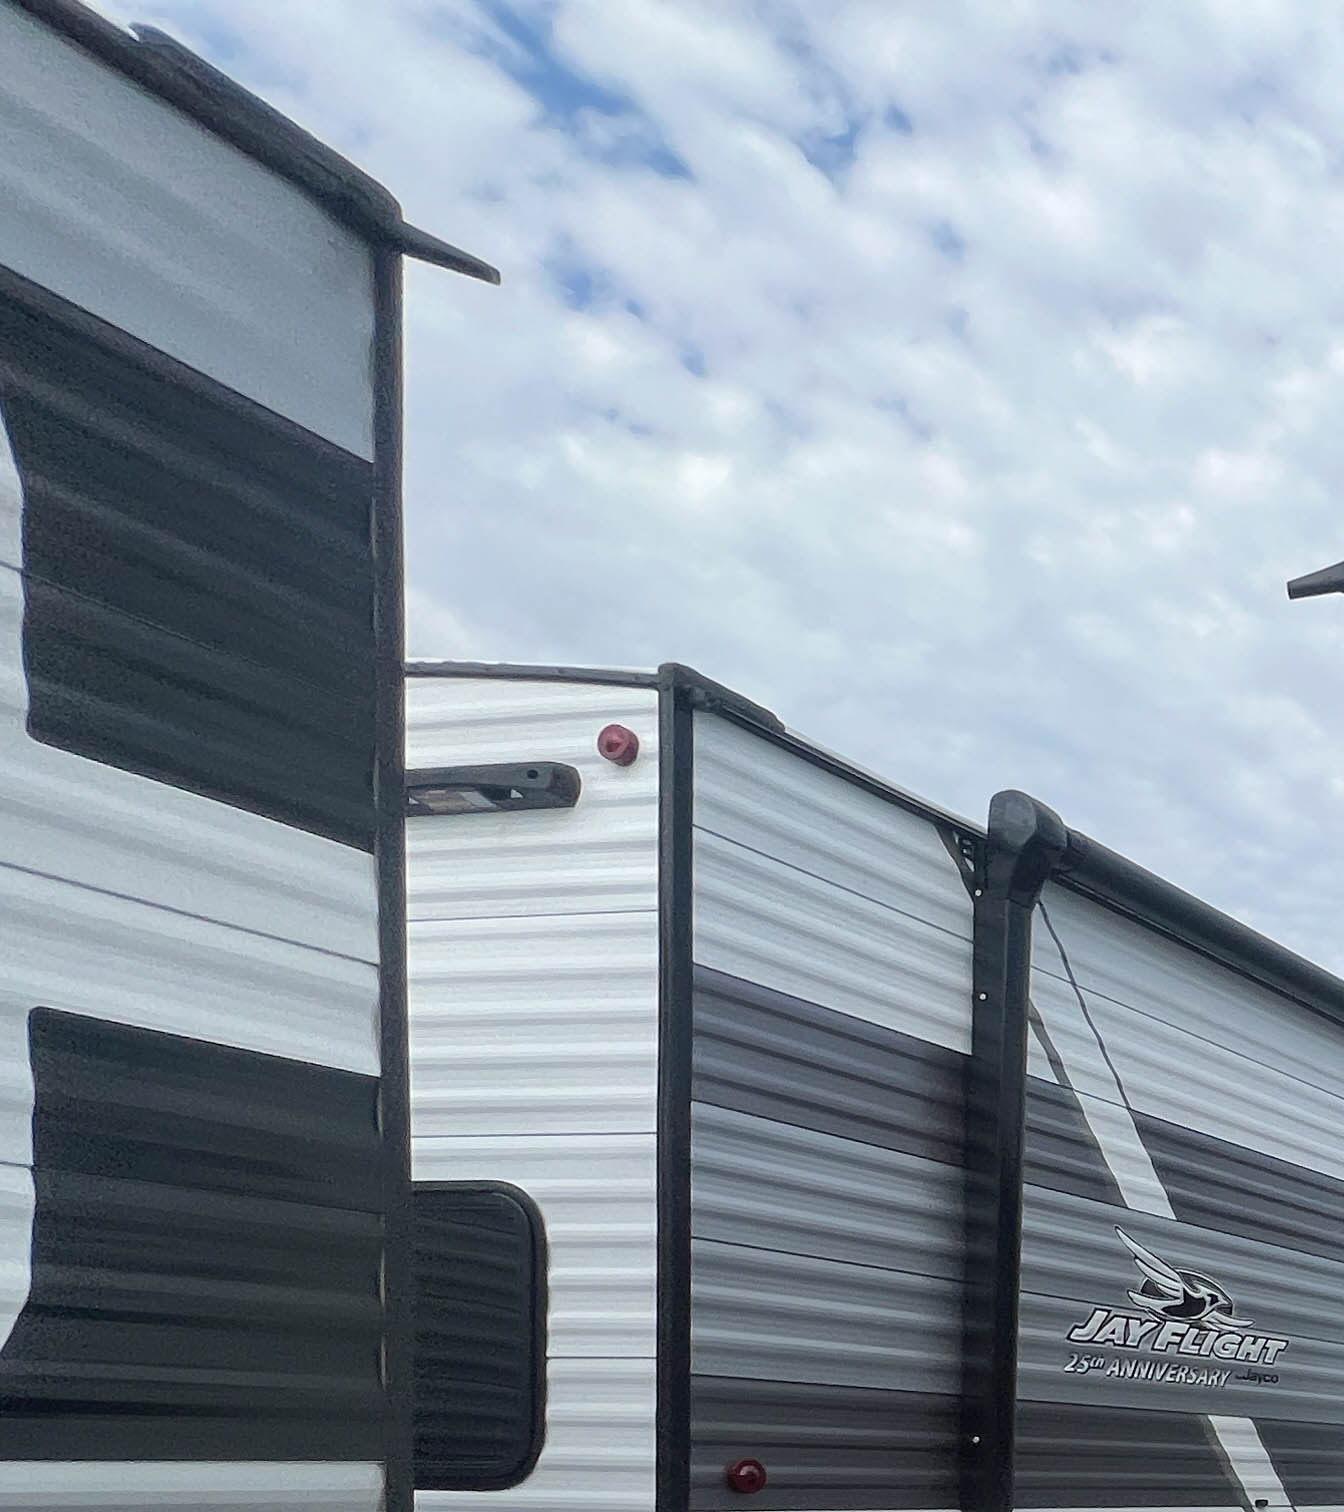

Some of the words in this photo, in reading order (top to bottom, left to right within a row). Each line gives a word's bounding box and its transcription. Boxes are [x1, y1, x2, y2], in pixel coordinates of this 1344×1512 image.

[1068, 1308, 1159, 1348] JAY
[1153, 1319, 1289, 1366] FLIGHT
[1063, 1353, 1106, 1375] 25th
[1106, 1358, 1232, 1388] ANNIVERSARY
